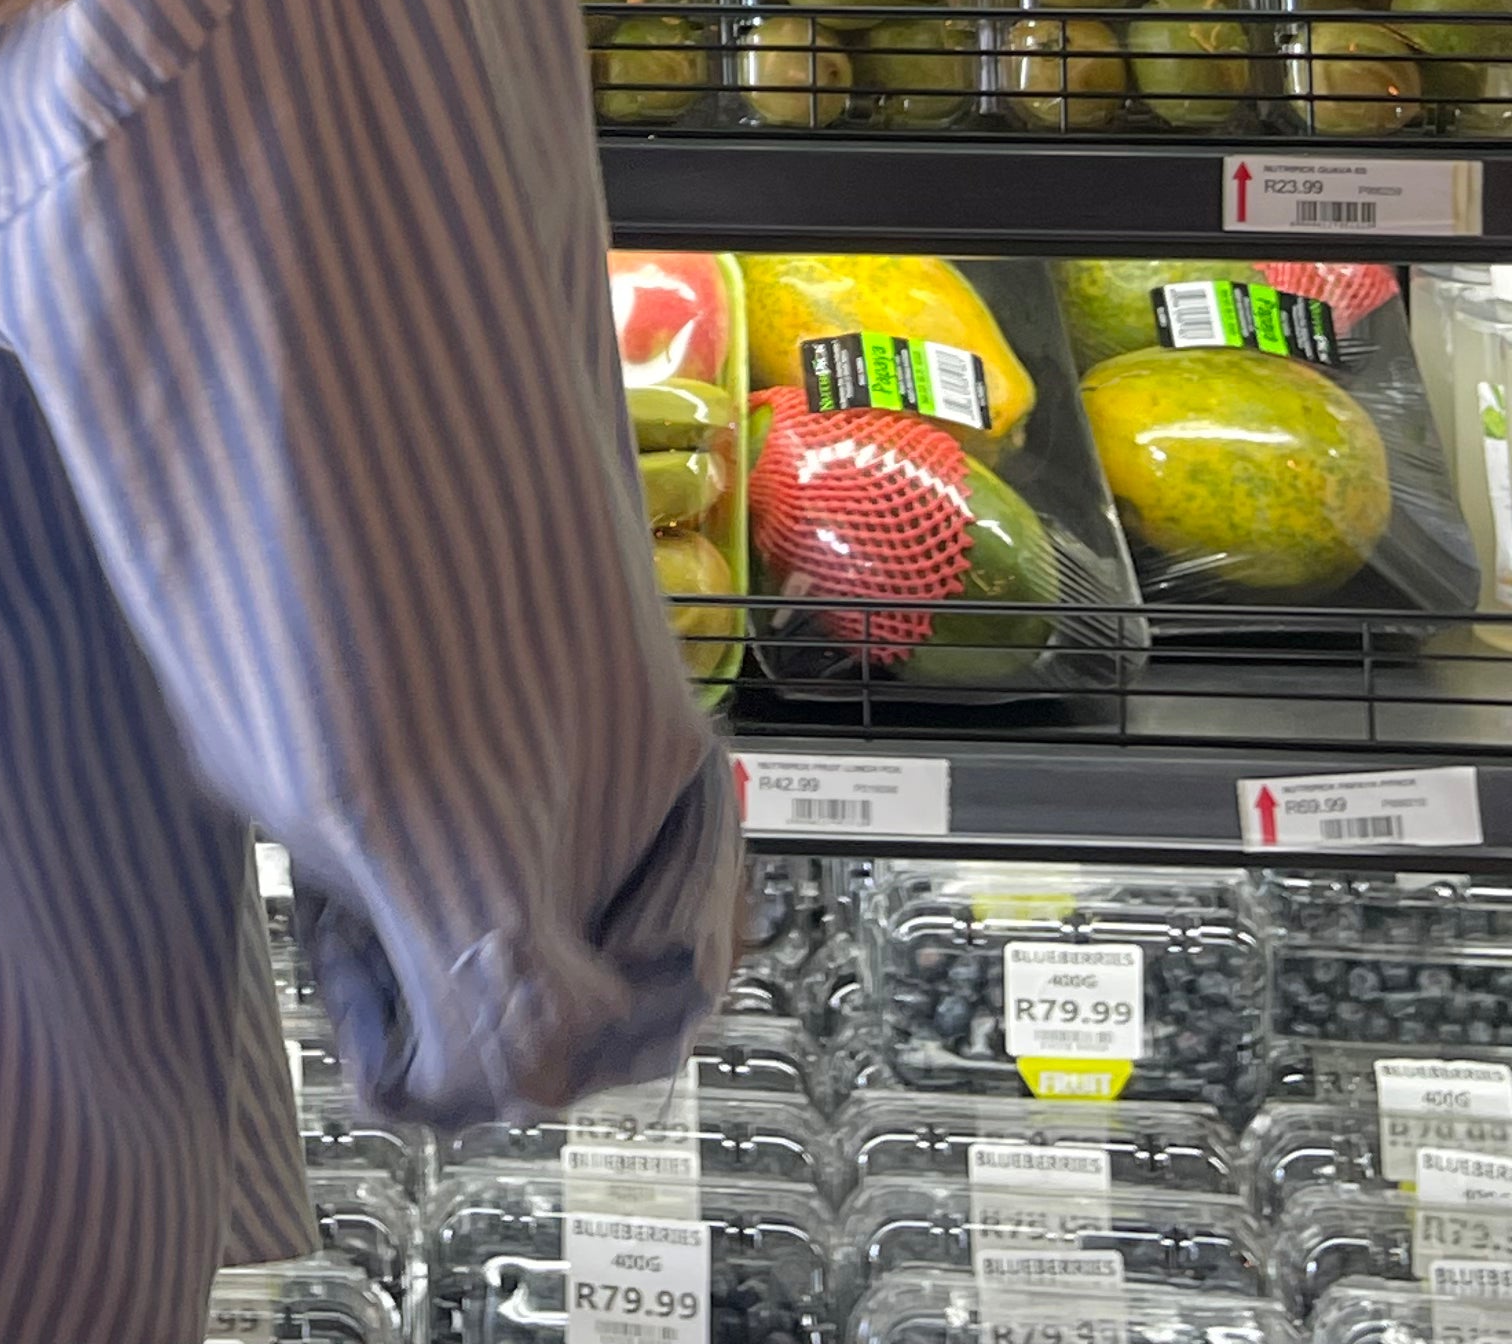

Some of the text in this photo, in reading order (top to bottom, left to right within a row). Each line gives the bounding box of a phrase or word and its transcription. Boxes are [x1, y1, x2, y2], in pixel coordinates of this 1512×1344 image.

[1264, 179, 1323, 194] R23.99
[872, 345, 895, 393] Papaya
[759, 777, 821, 792] R42.99
[1011, 949, 1135, 967] BLUEBERRIES
[1015, 997, 1133, 1025] R79.99
[1039, 1070, 1113, 1096] FRUIT
[975, 1149, 1104, 1174] BLUEBERRIES
[573, 1218, 703, 1247] BLUEBERRIES
[575, 1281, 699, 1320] R79.99
